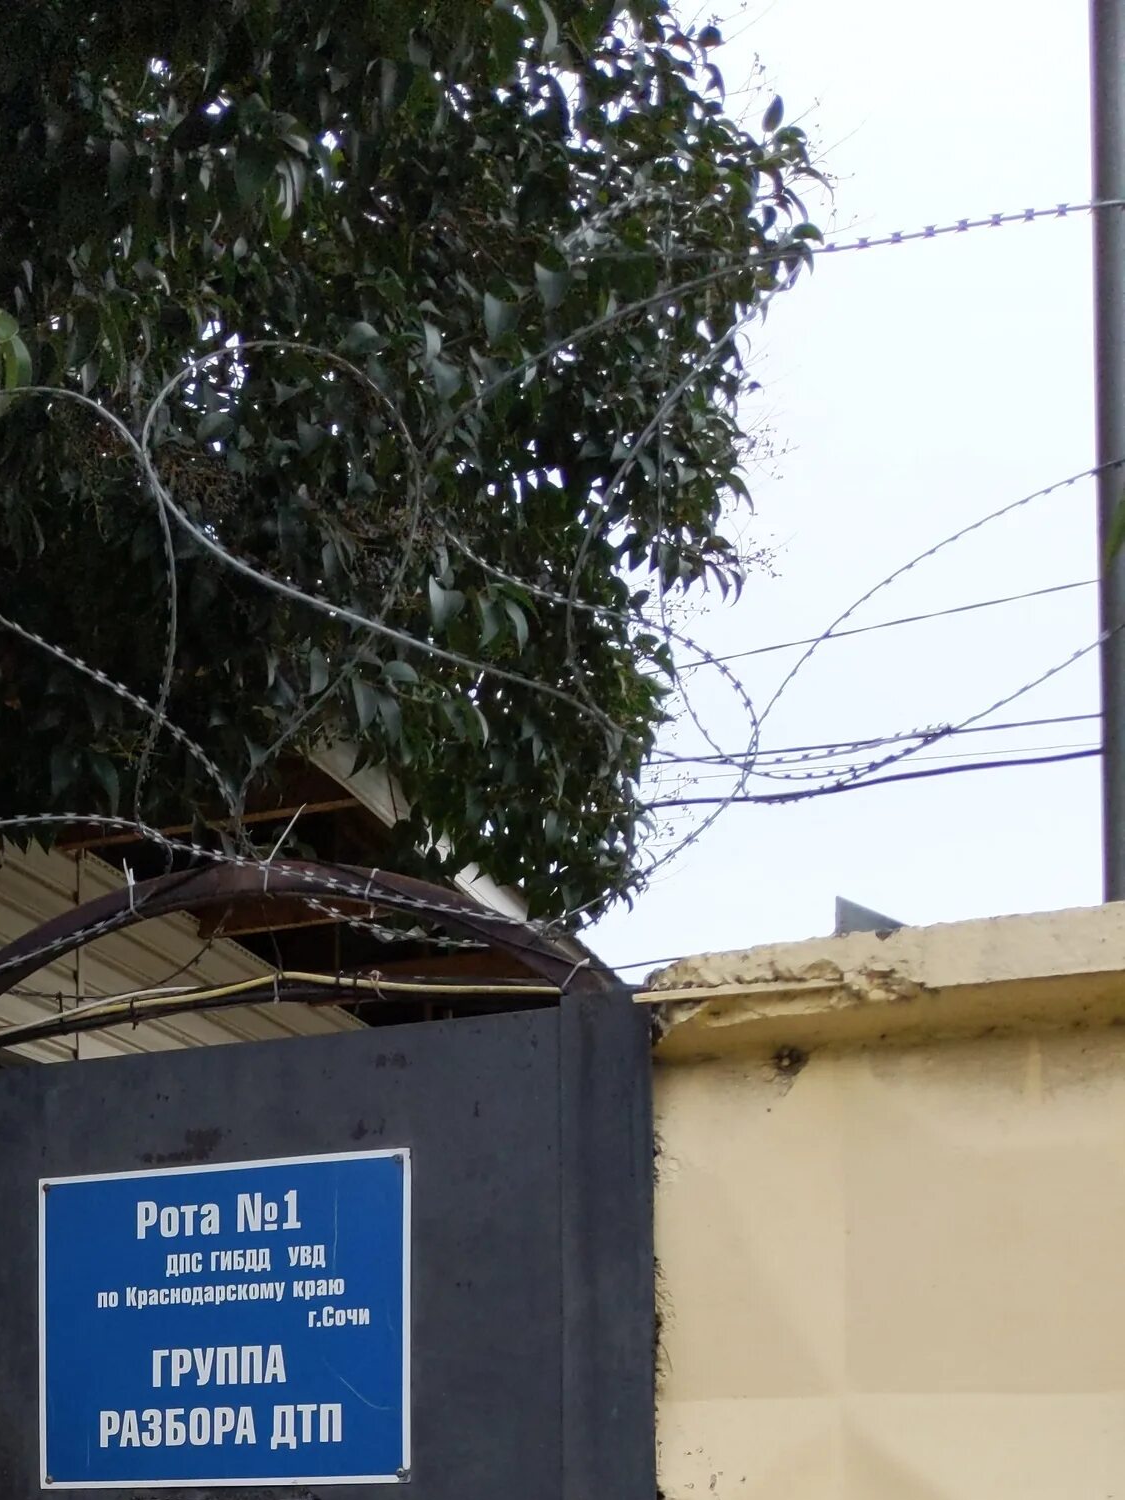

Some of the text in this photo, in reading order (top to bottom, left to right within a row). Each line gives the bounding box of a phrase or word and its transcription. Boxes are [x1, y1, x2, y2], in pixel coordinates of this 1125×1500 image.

[136, 1189, 302, 1240] Рота №1
[165, 1244, 326, 1277] ДПС ГИБДД УВД
[97, 1278, 345, 1309] по Краснодарскому краю
[308, 1306, 371, 1328] г.Сочи
[151, 1344, 287, 1388] ГРУППА
[99, 1403, 343, 1450] РАЗБОРА ДТП
